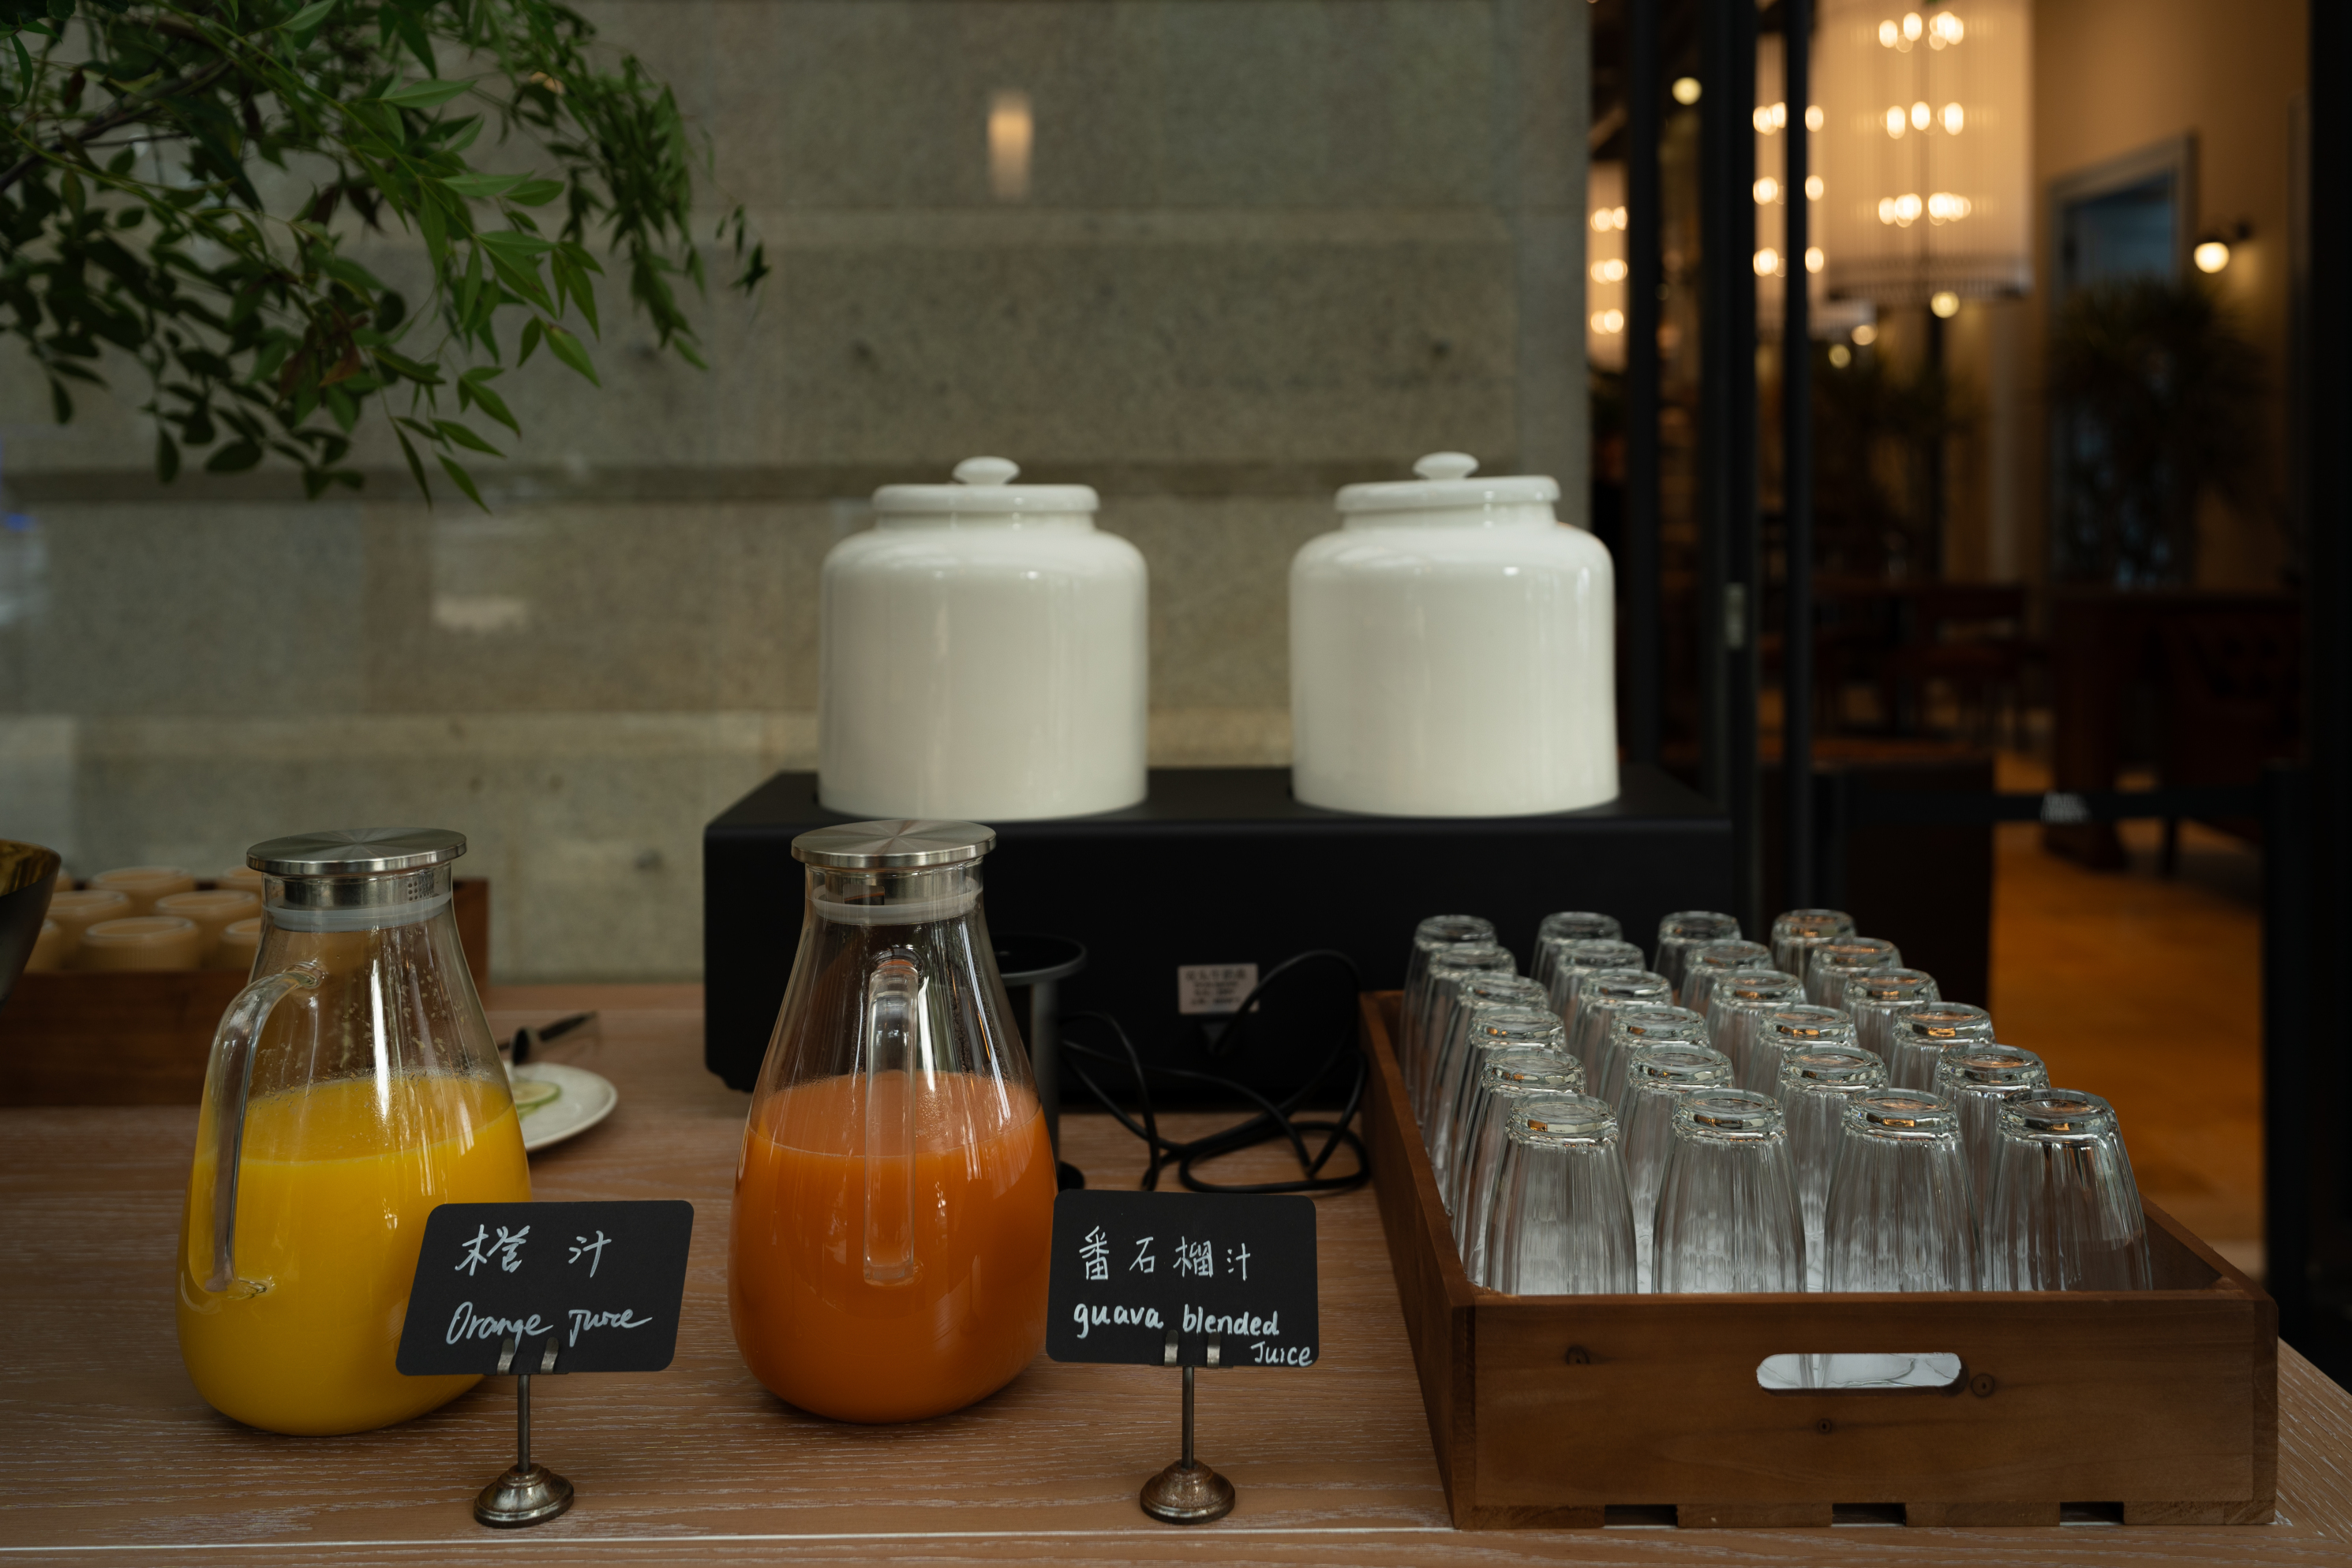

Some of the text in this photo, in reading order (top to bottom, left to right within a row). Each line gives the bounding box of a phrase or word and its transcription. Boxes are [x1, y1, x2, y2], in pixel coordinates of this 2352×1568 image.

[1079, 1226, 1250, 1281] 番石榴汁
[446, 1302, 553, 1355] Orange
[1073, 1303, 1279, 1338] guava blended
[1250, 1341, 1312, 1367] Juice
